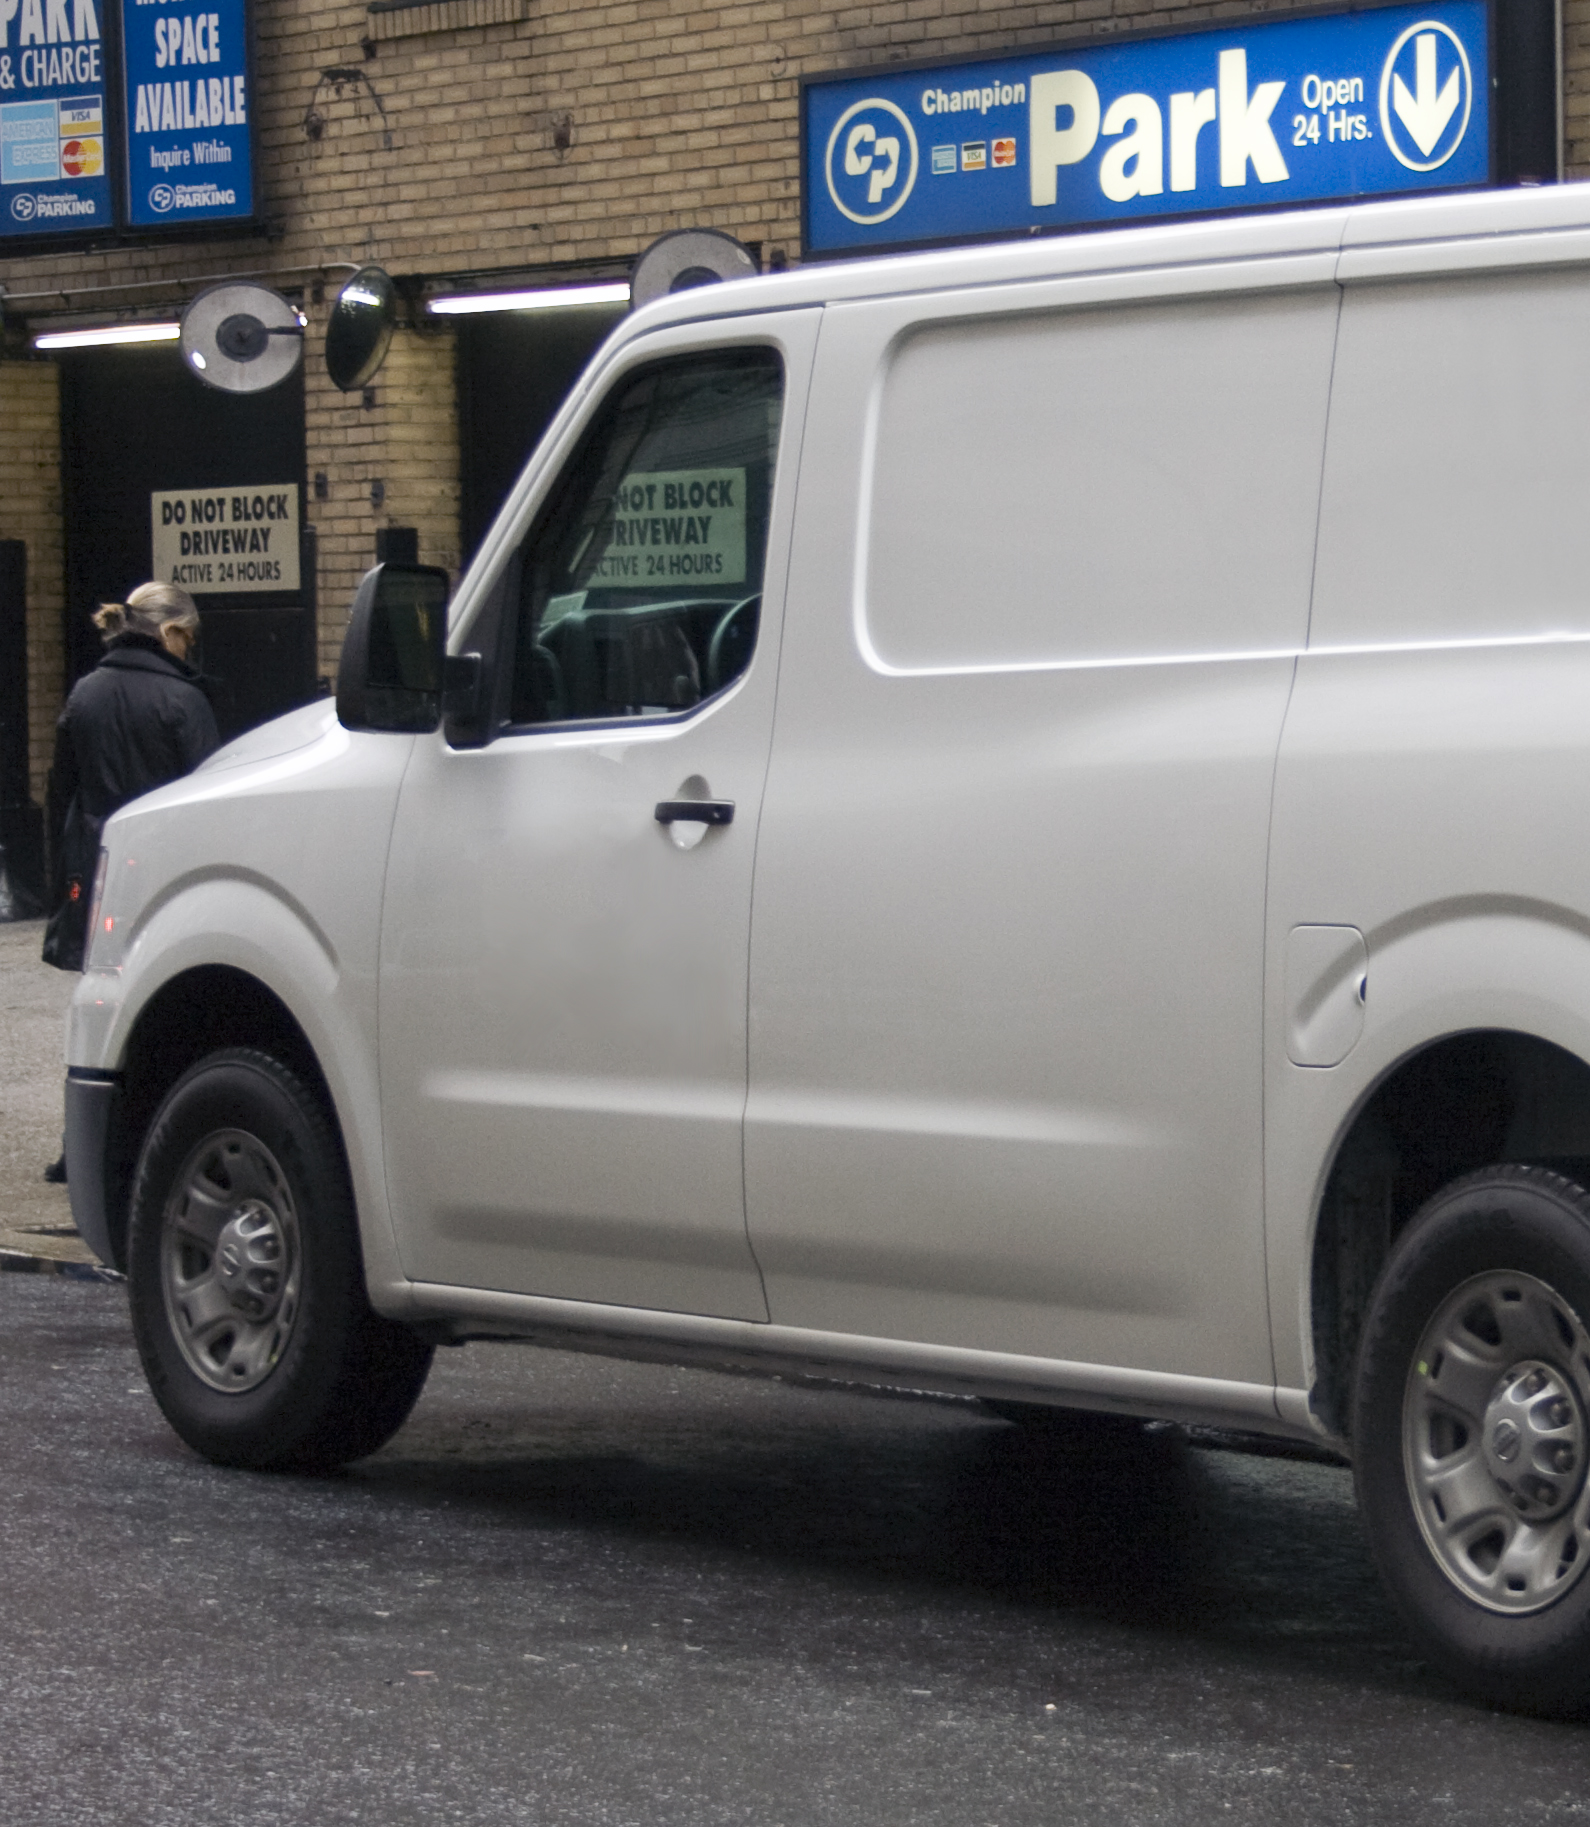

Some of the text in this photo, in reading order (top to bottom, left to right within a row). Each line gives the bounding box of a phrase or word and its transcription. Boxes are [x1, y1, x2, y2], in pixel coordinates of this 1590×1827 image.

[155, 13, 221, 68] SPACE
[0, 43, 101, 89] & CHARGE
[135, 75, 246, 133] AVAILABLE
[921, 80, 1026, 115] Champion
[1302, 75, 1364, 115] Open
[71, 111, 91, 122] VISA
[1031, 49, 1290, 206] Park
[1293, 110, 1373, 146] 24 Hrs.
[150, 138, 232, 172] Inquire Within
[37, 200, 95, 217] PARKING
[175, 189, 236, 208] PARKING
[162, 494, 288, 525] DO NOT BLOCK
[664, 479, 735, 510] BLOCK
[180, 527, 271, 556] DRIVEWAY
[615, 516, 712, 546] RIVEWAY
[172, 561, 281, 583] ACTIVE 24 HOURS
[597, 553, 723, 577] CTIVE 24 HOURS
